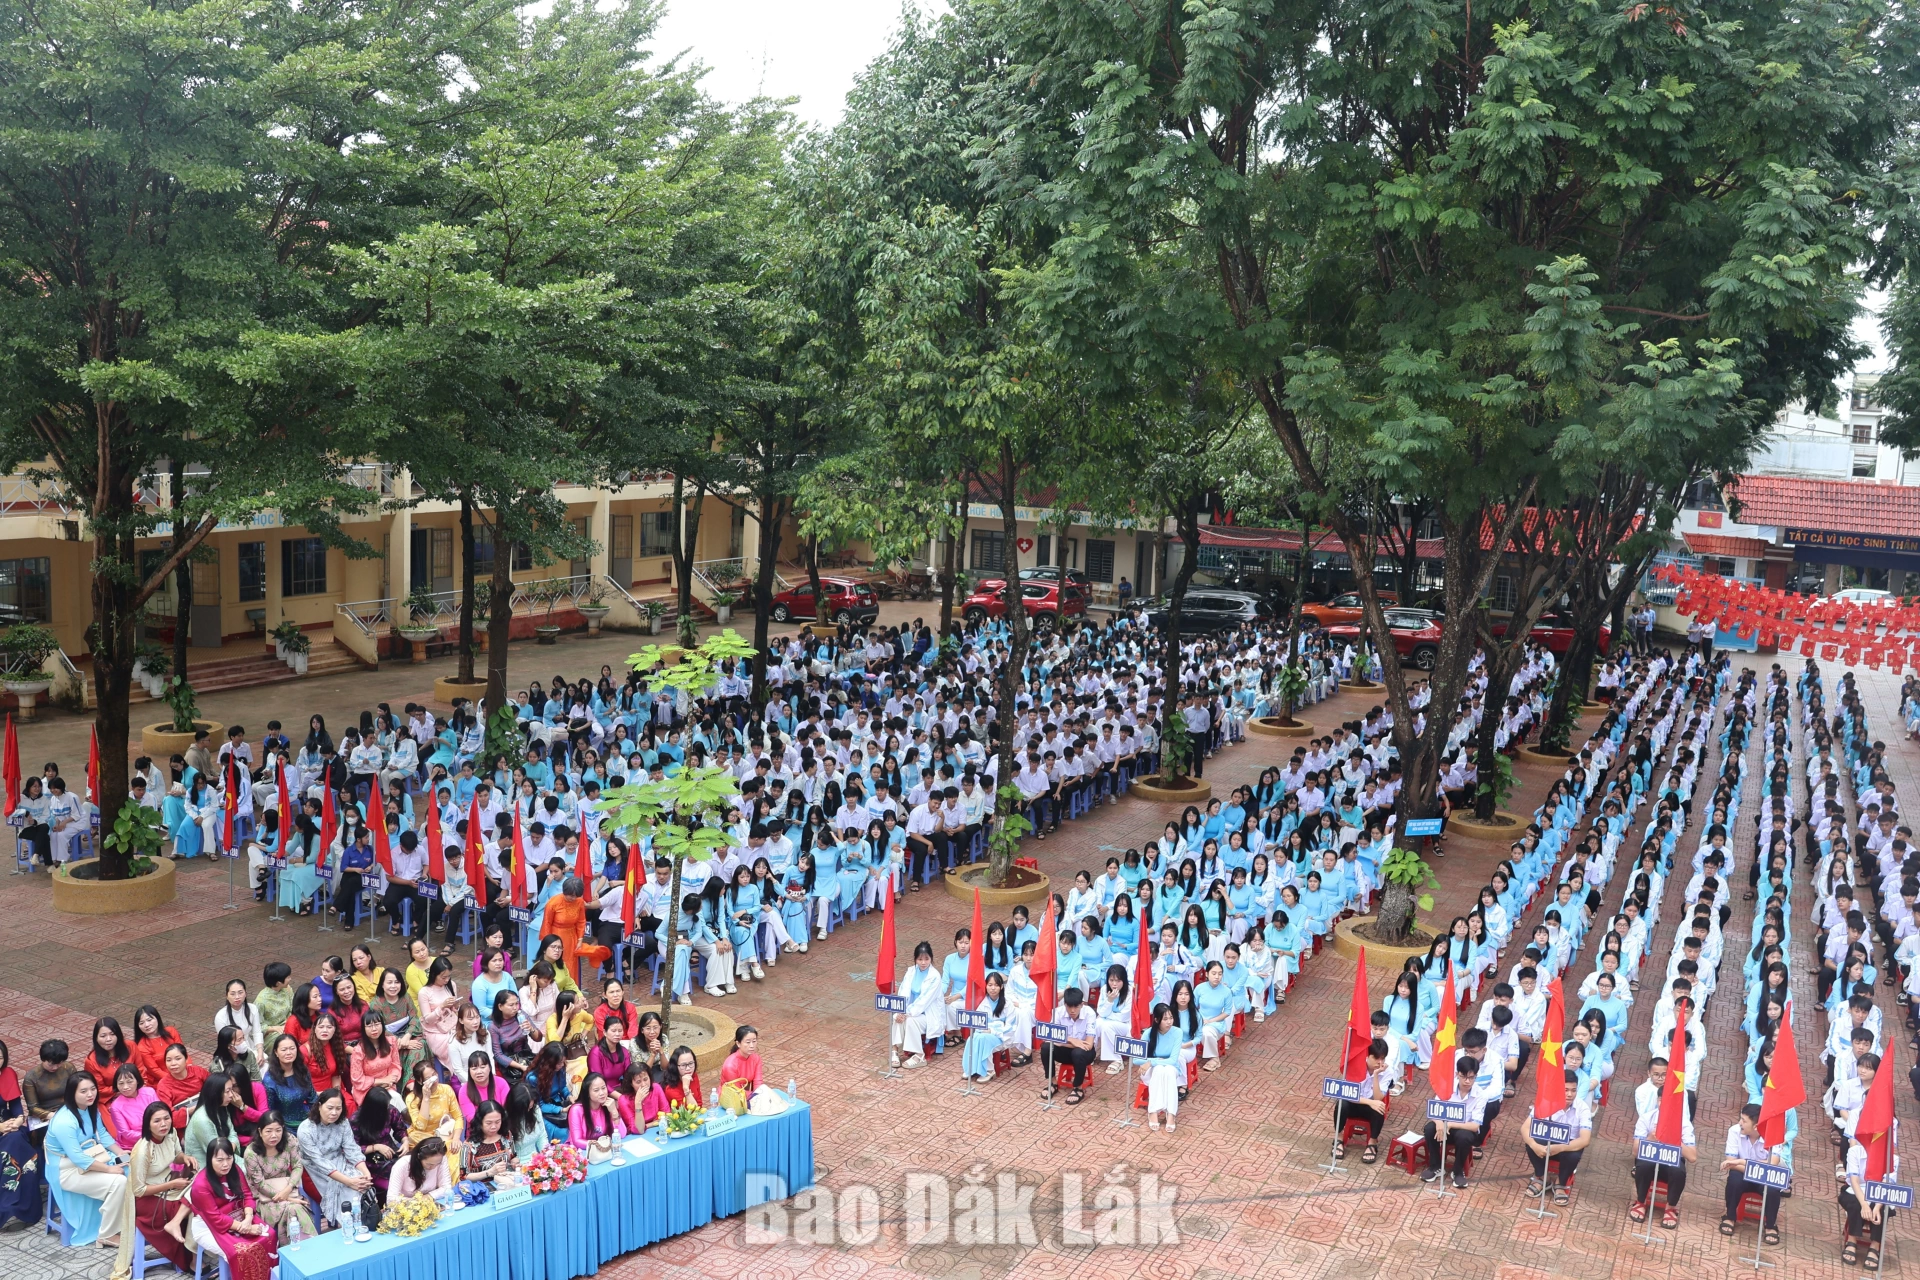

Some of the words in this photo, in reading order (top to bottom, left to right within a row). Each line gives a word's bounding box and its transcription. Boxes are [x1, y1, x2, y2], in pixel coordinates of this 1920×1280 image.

[253, 513, 274, 527] HỌC
[1789, 530, 1808, 542] TẤT
[1810, 532, 1824, 543] CẢ
[1827, 533, 1837, 544] VÌ
[1839, 536, 1860, 547] HỌC
[1863, 538, 1886, 548] SINH
[1890, 539, 1918, 550] THÂN
[362, 874, 370, 886] LỚP
[370, 877, 380, 888] 12A6
[419, 884, 428, 895] LỚP
[465, 896, 473, 907] LỚP
[510, 908, 518, 920] LỚP
[632, 934, 643, 946] 12A1
[877, 996, 889, 1009] LỚP
[890, 998, 904, 1011] 10A1
[958, 1012, 970, 1025] LỚP
[971, 1015, 986, 1027] 10A2
[1038, 1024, 1049, 1037] LỚP
[1051, 1027, 1066, 1040] 10A3
[1118, 1039, 1129, 1053] LỚP
[1130, 1043, 1144, 1056] 10A4
[1325, 1080, 1339, 1095] LỚP
[1341, 1084, 1358, 1098] 10A5
[1430, 1102, 1444, 1117] LỚP
[1446, 1106, 1463, 1120] 10A6
[1532, 1121, 1547, 1137] LỚP
[1549, 1126, 1568, 1141] 10A7
[1641, 1143, 1657, 1159] LỚP
[1659, 1147, 1678, 1163] 10A8
[1747, 1163, 1764, 1180] LỚP
[1766, 1169, 1786, 1186] 10A9
[497, 1194, 513, 1204] GIÁO
[514, 1189, 529, 1198] VIÊN
